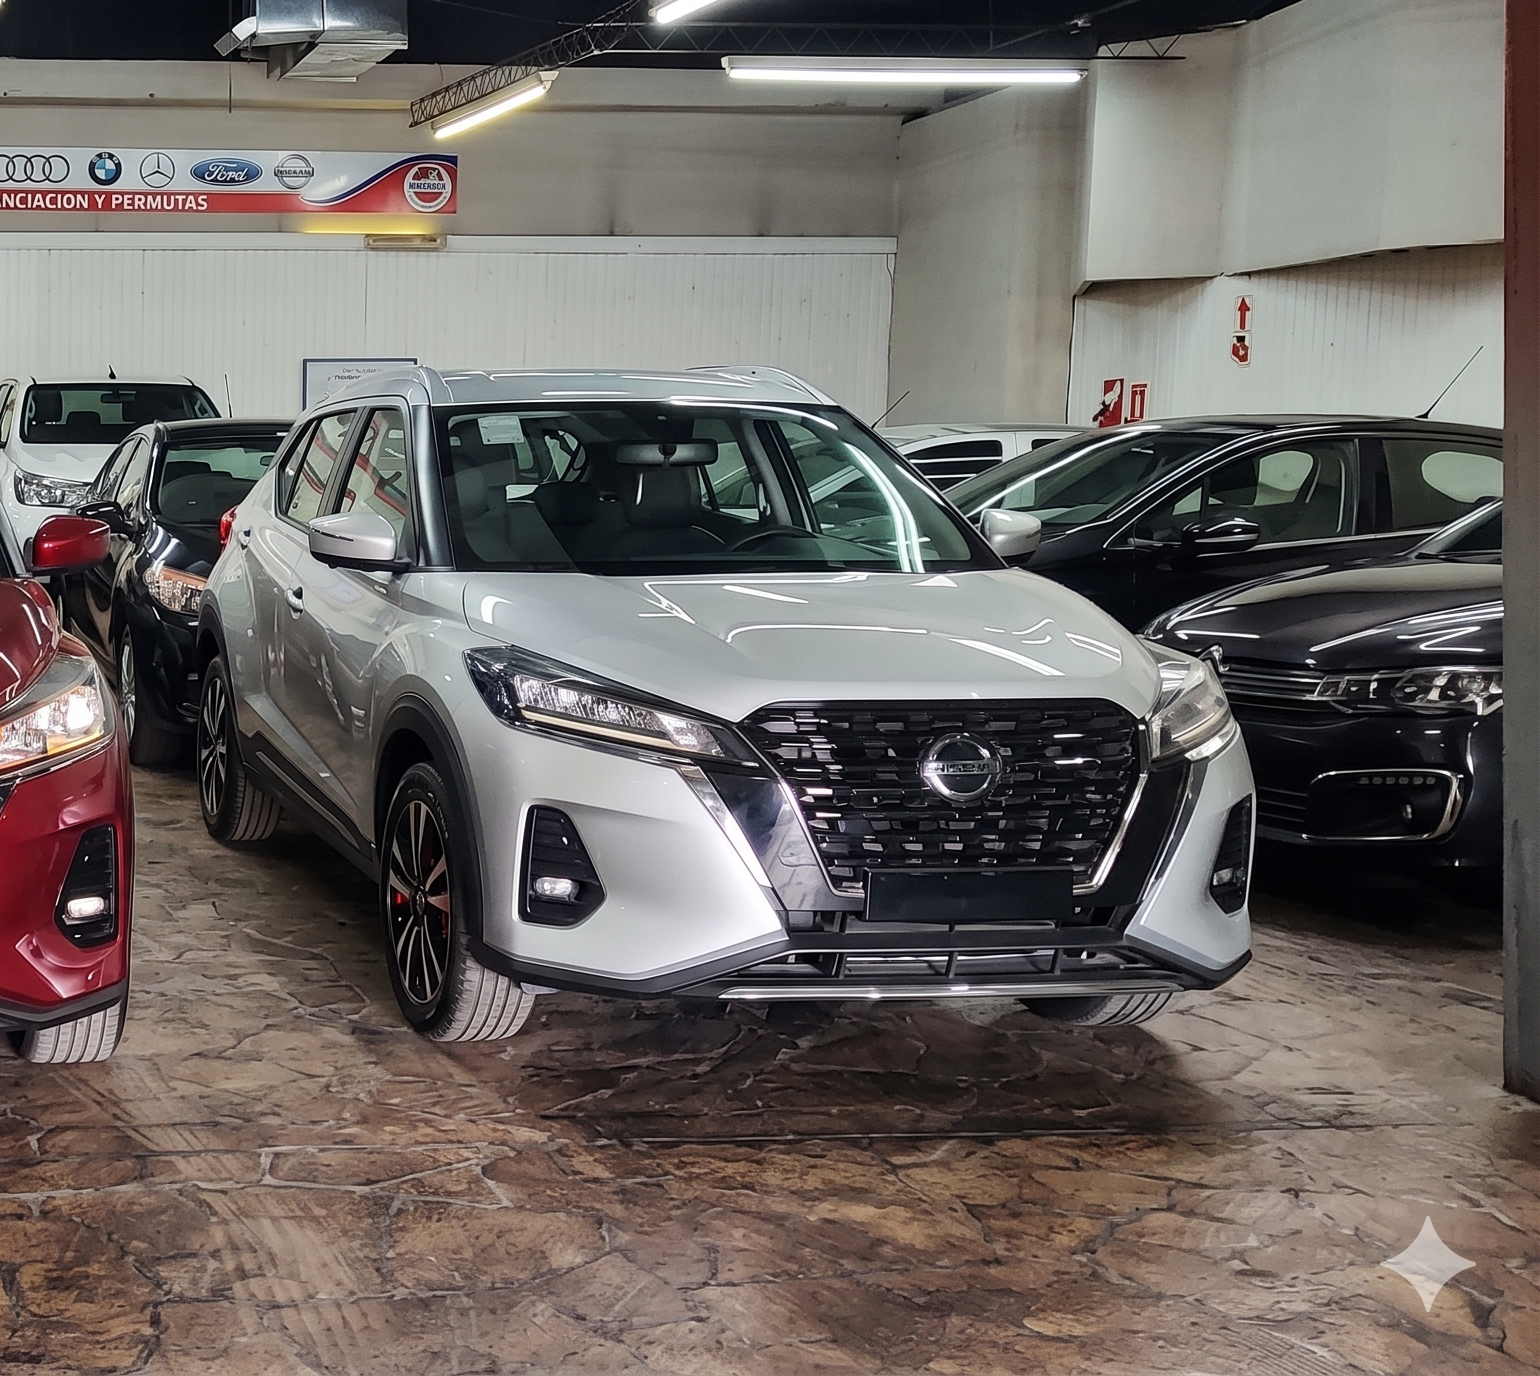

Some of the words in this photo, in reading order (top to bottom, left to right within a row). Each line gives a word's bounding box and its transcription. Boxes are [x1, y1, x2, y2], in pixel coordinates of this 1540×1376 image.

[204, 162, 249, 181] Ford
[94, 194, 106, 209] Y
[111, 194, 208, 210] PERMUTAS
